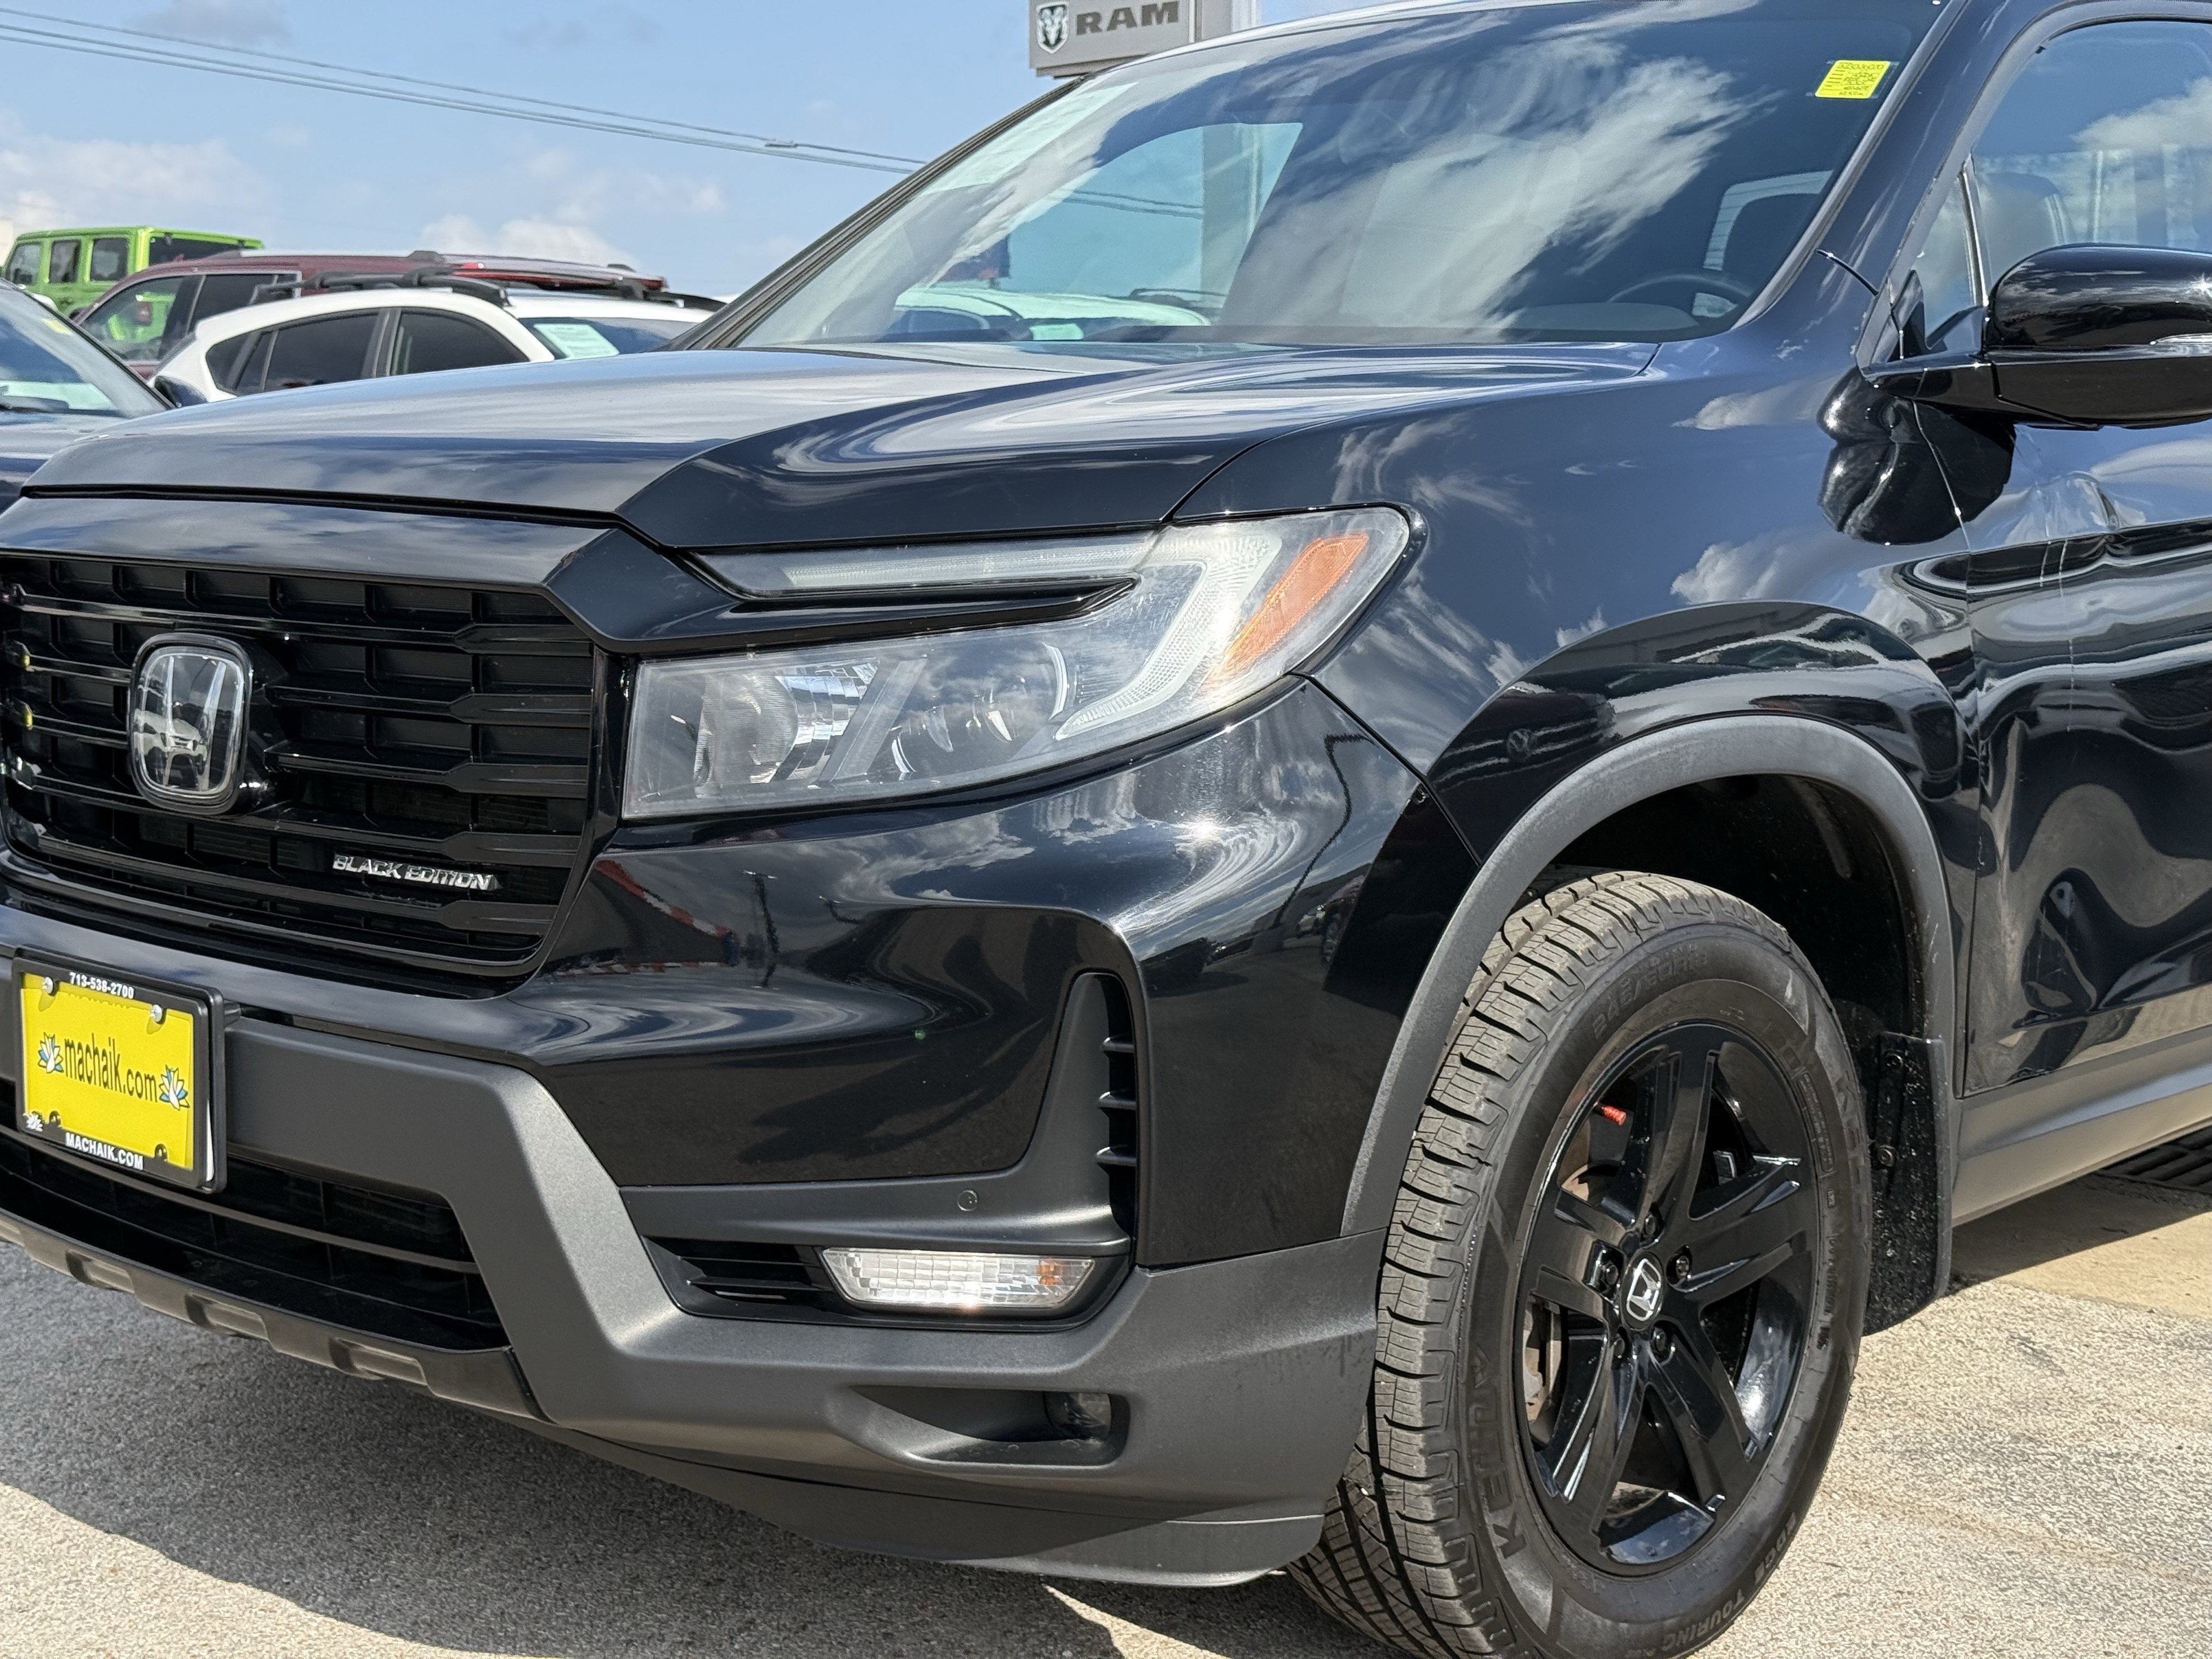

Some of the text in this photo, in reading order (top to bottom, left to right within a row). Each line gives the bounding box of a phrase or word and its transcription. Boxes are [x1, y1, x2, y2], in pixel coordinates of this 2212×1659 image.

[1076, 1, 1180, 36] RAM
[332, 854, 493, 891] BLACK EDITION
[69, 972, 135, 999] 713-538-2700
[64, 1032, 159, 1103] machaik.com
[65, 1132, 144, 1170] MACHAIK.COM
[1661, 1589, 1745, 1651] TOURING
